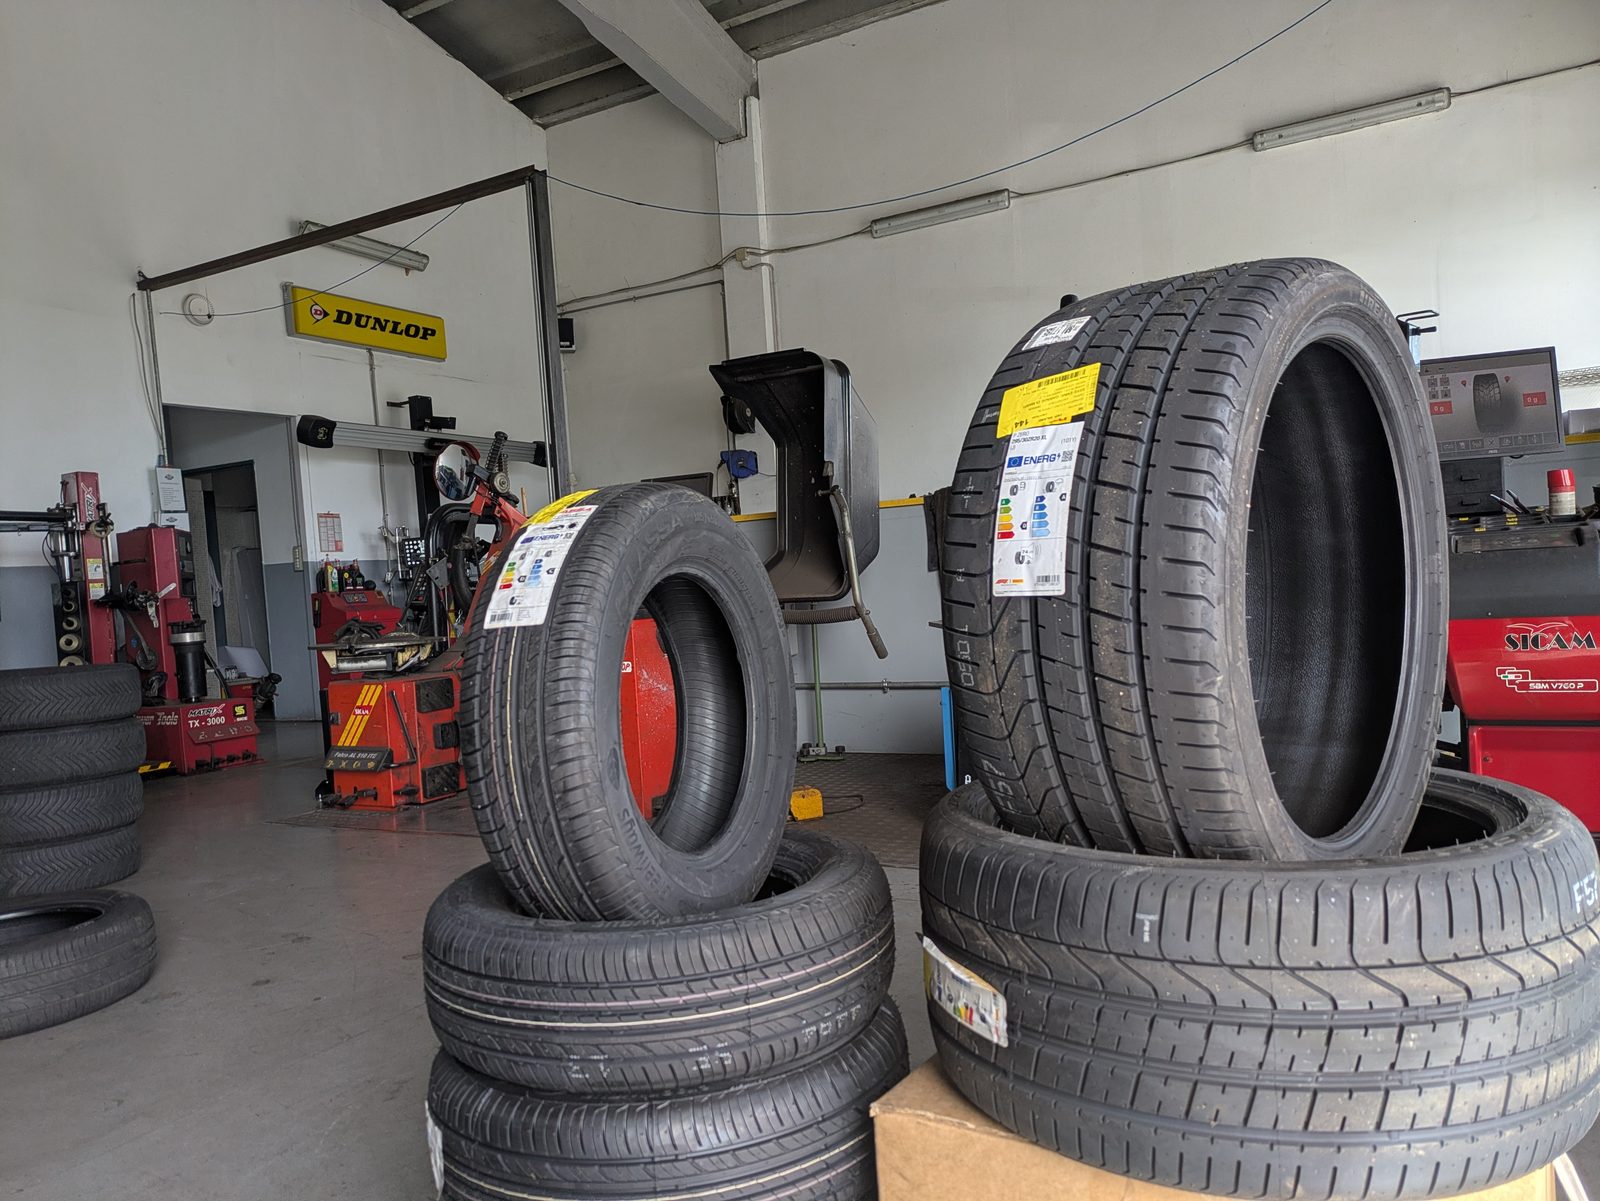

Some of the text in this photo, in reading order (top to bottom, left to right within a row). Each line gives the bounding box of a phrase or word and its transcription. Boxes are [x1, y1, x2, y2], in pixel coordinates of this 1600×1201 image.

[333, 309, 437, 341] DUNLOP
[1023, 453, 1056, 466] ENERG
[81, 482, 97, 521] ATRIX
[1504, 630, 1598, 652] SICAM
[1529, 682, 1584, 690] SBM V760 P
[188, 703, 226, 718] MATRIX
[156, 711, 179, 726] Tools
[188, 719, 200, 729] TX
[206, 716, 226, 726] 3000
